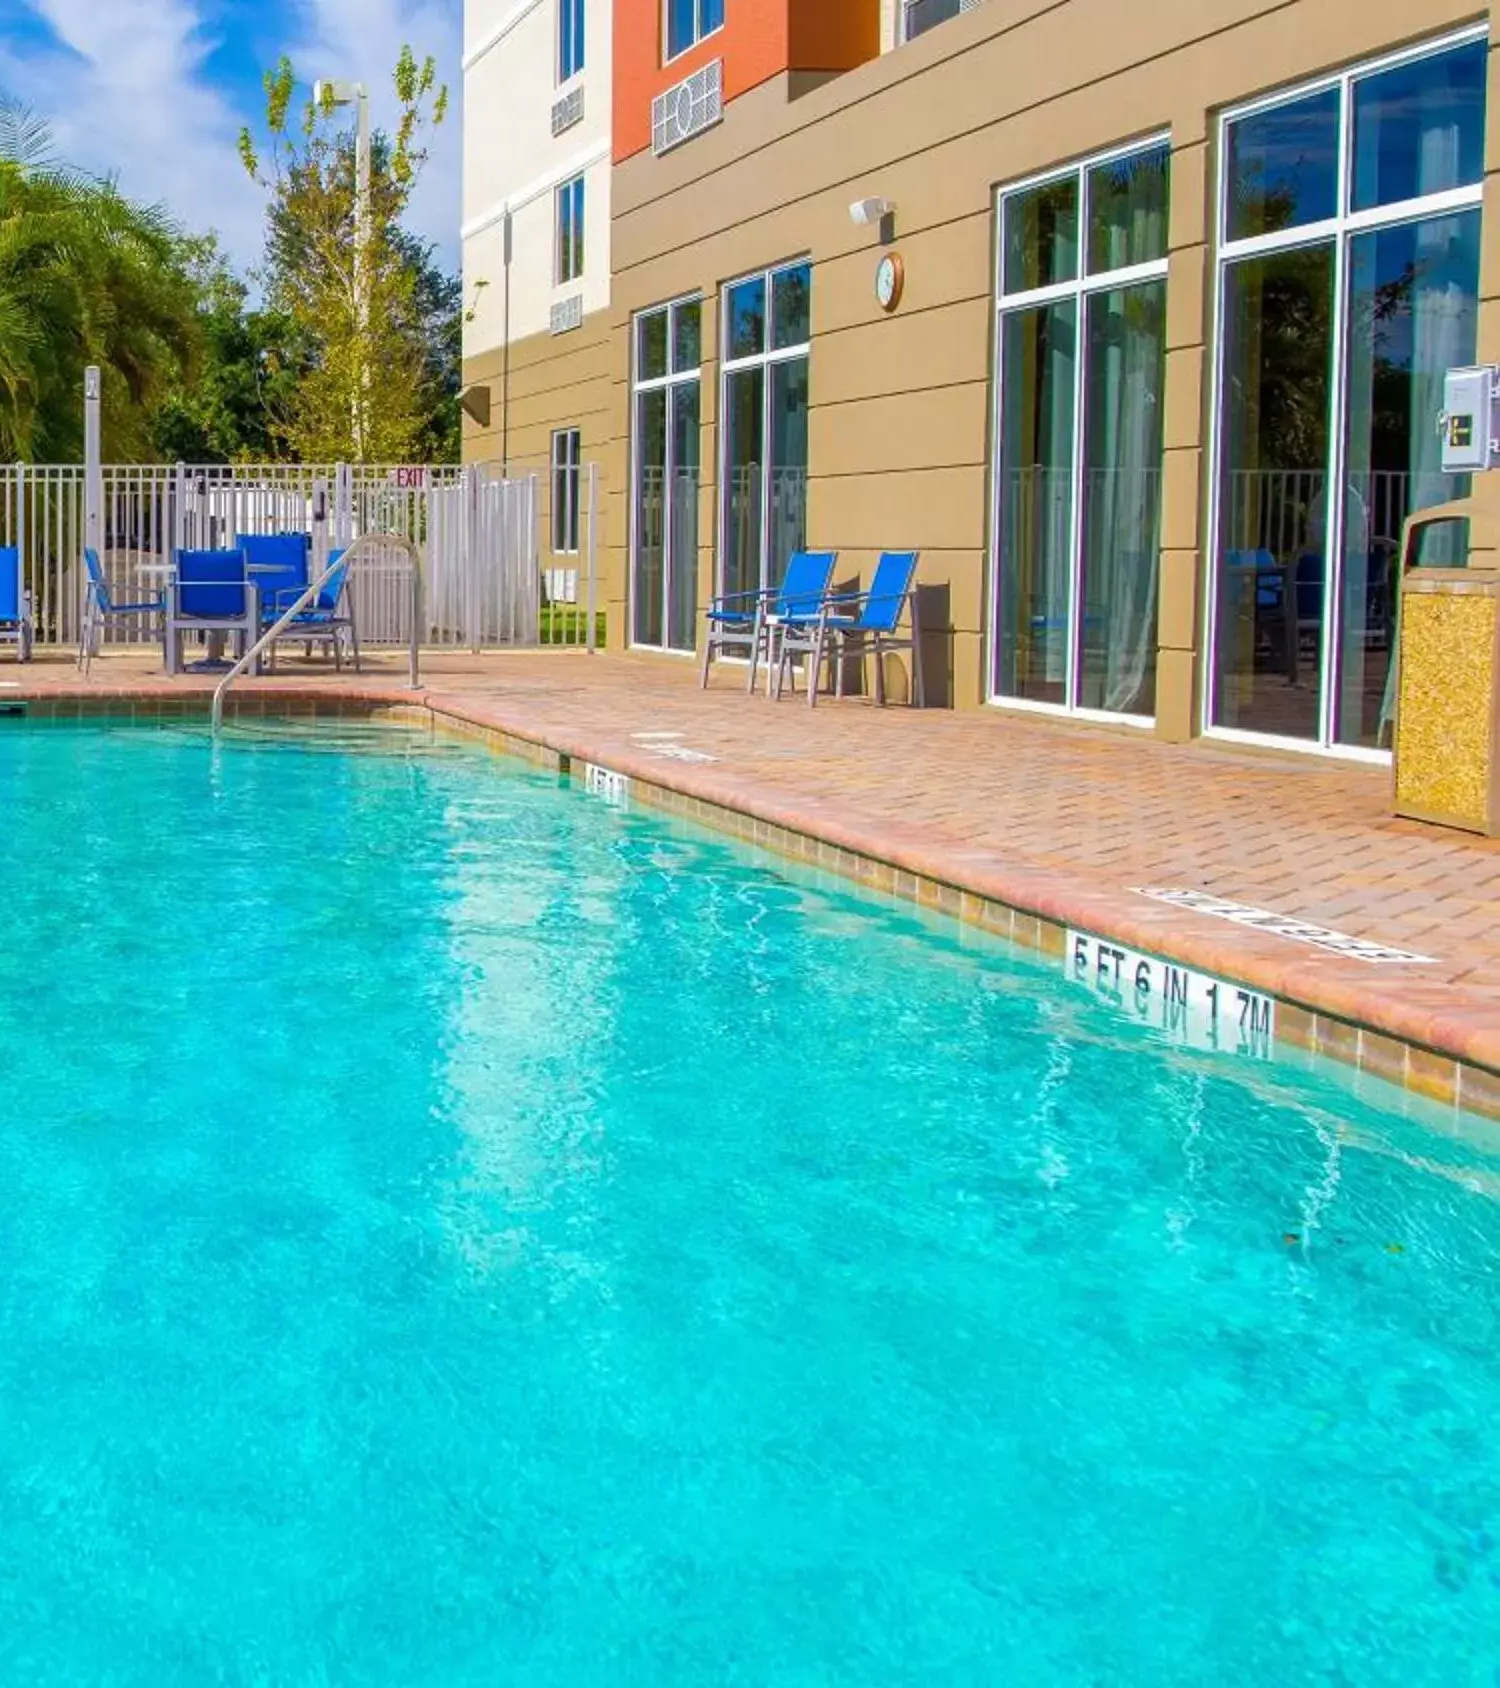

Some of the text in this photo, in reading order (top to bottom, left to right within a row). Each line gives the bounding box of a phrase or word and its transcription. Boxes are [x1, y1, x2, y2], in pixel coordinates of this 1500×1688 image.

[397, 467, 425, 487] EXIT
[1075, 936, 1269, 1035] 5 FT 6 IN 1 7M
